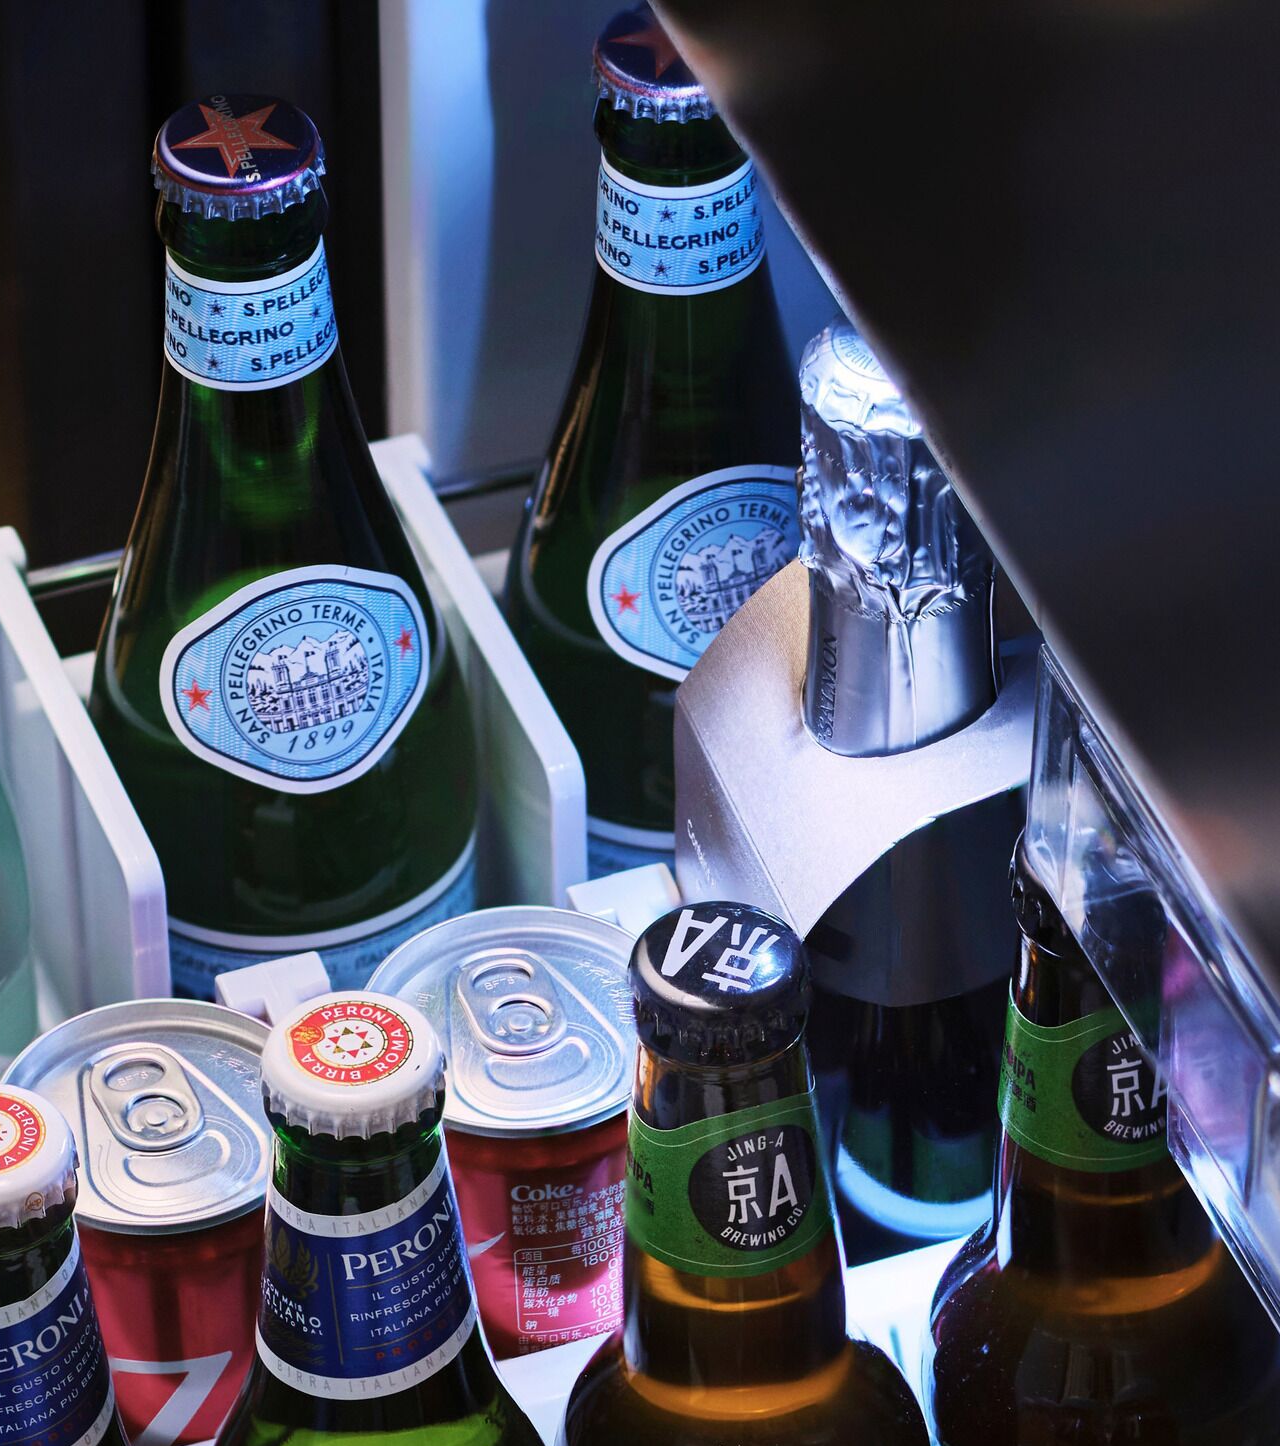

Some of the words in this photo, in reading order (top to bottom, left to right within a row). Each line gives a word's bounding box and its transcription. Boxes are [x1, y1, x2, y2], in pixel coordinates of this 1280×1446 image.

[603, 210, 740, 250] S.PELLEGRINO
[738, 503, 790, 531] TERME
[657, 507, 730, 602] PELLEGRINO
[312, 604, 367, 633] TERME
[665, 610, 701, 645] SAN
[228, 608, 303, 700] PELLEGRINO
[362, 652, 384, 713] ITALIA
[235, 708, 271, 744] SAN
[288, 719, 354, 754] 1899
[321, 1006, 391, 1024] PERONI
[301, 1053, 361, 1080] BIRRA
[374, 1028, 405, 1072] ROMA
[7, 1103, 38, 1152] PERONI
[727, 1131, 784, 1162] JING-A
[333, 1188, 429, 1233] ITALIANA
[720, 1225, 786, 1247] BREWING
[787, 1204, 807, 1226] CO.
[342, 1192, 454, 1281] PERONI
[350, 1272, 448, 1322] RINFRESCANTE
[372, 1293, 384, 1301] IL
[391, 1263, 435, 1295] GUSTO
[523, 1288, 548, 1298] 脂肪
[282, 1294, 303, 1312] MAIS
[524, 1294, 577, 1309] 碳水化合物
[371, 1307, 431, 1337] ITALIANA
[11, 1364, 61, 1395] GUSTO
[63, 1325, 91, 1365] UNICO
[349, 1349, 446, 1392] ITALIANA
[59, 1387, 80, 1408] PIÙ
